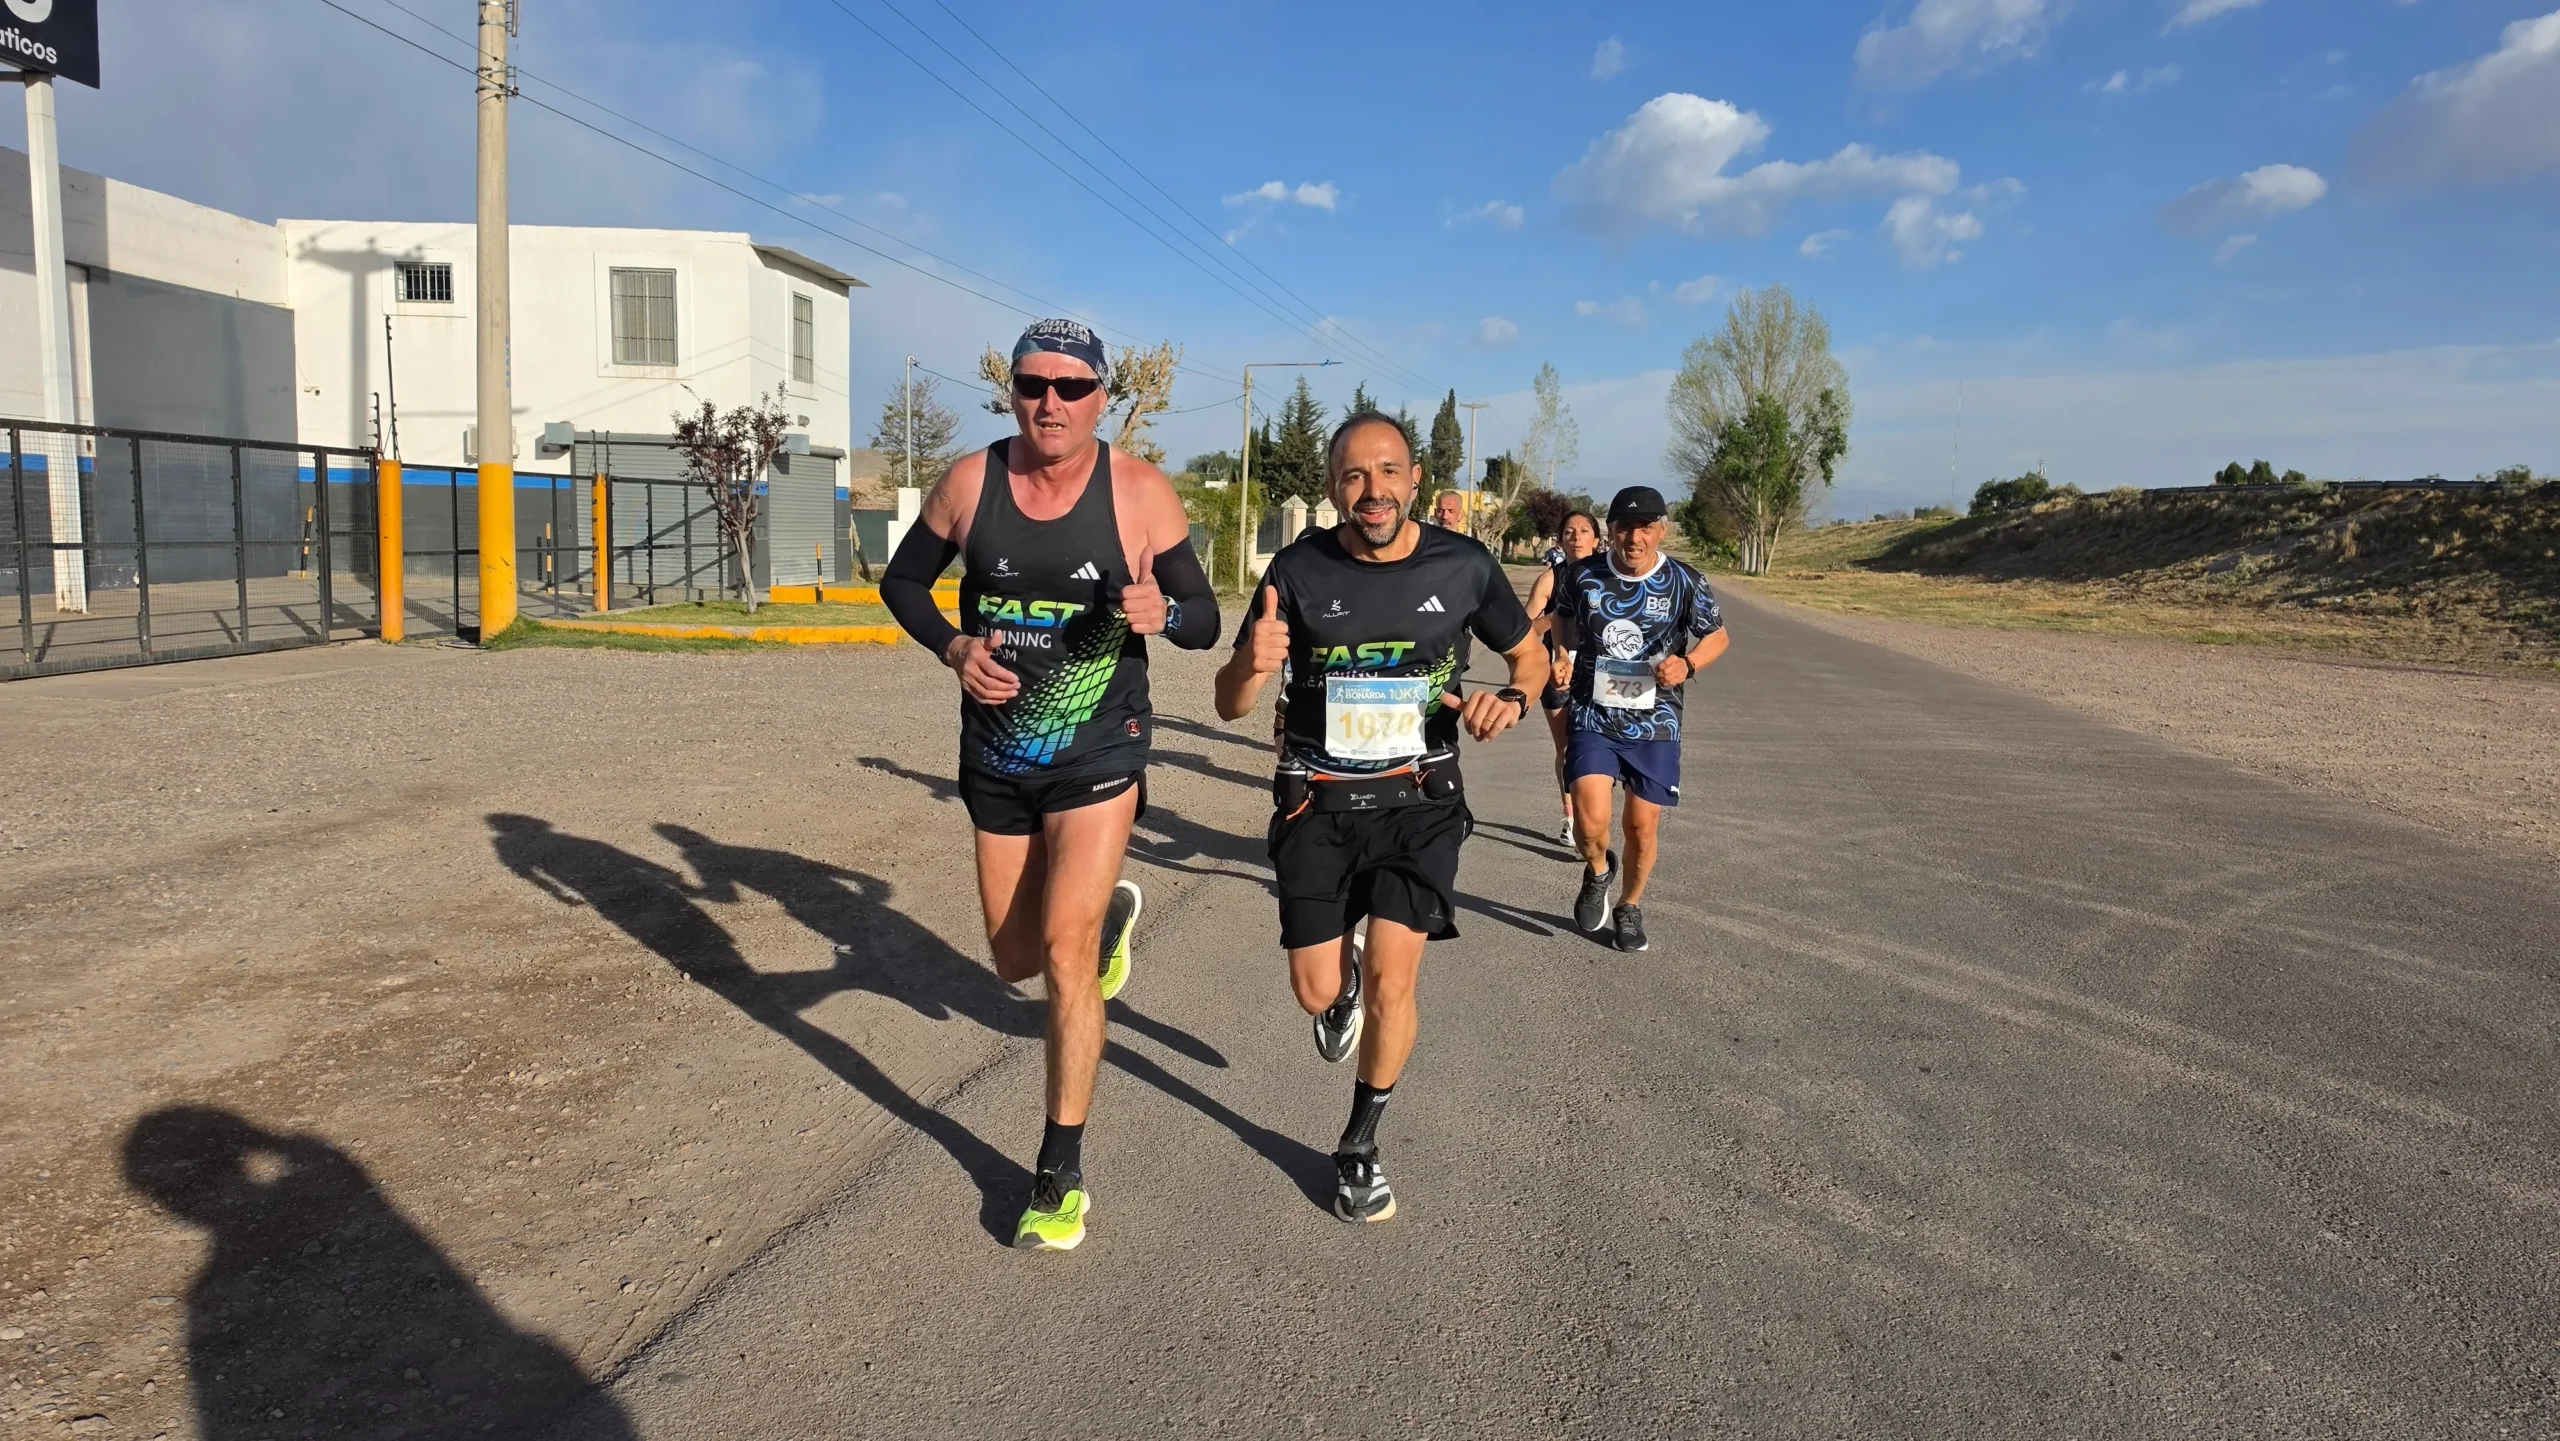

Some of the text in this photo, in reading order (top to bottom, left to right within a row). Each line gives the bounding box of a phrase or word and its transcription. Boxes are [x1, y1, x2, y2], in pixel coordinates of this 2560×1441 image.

[978, 594, 1086, 629] FAST
[977, 624, 1053, 649] RUNING
[1345, 691, 1387, 700] BONARDA
[1389, 688, 1413, 700] 10K
[1605, 679, 1643, 699] 273
[1339, 711, 1415, 740] 1070
